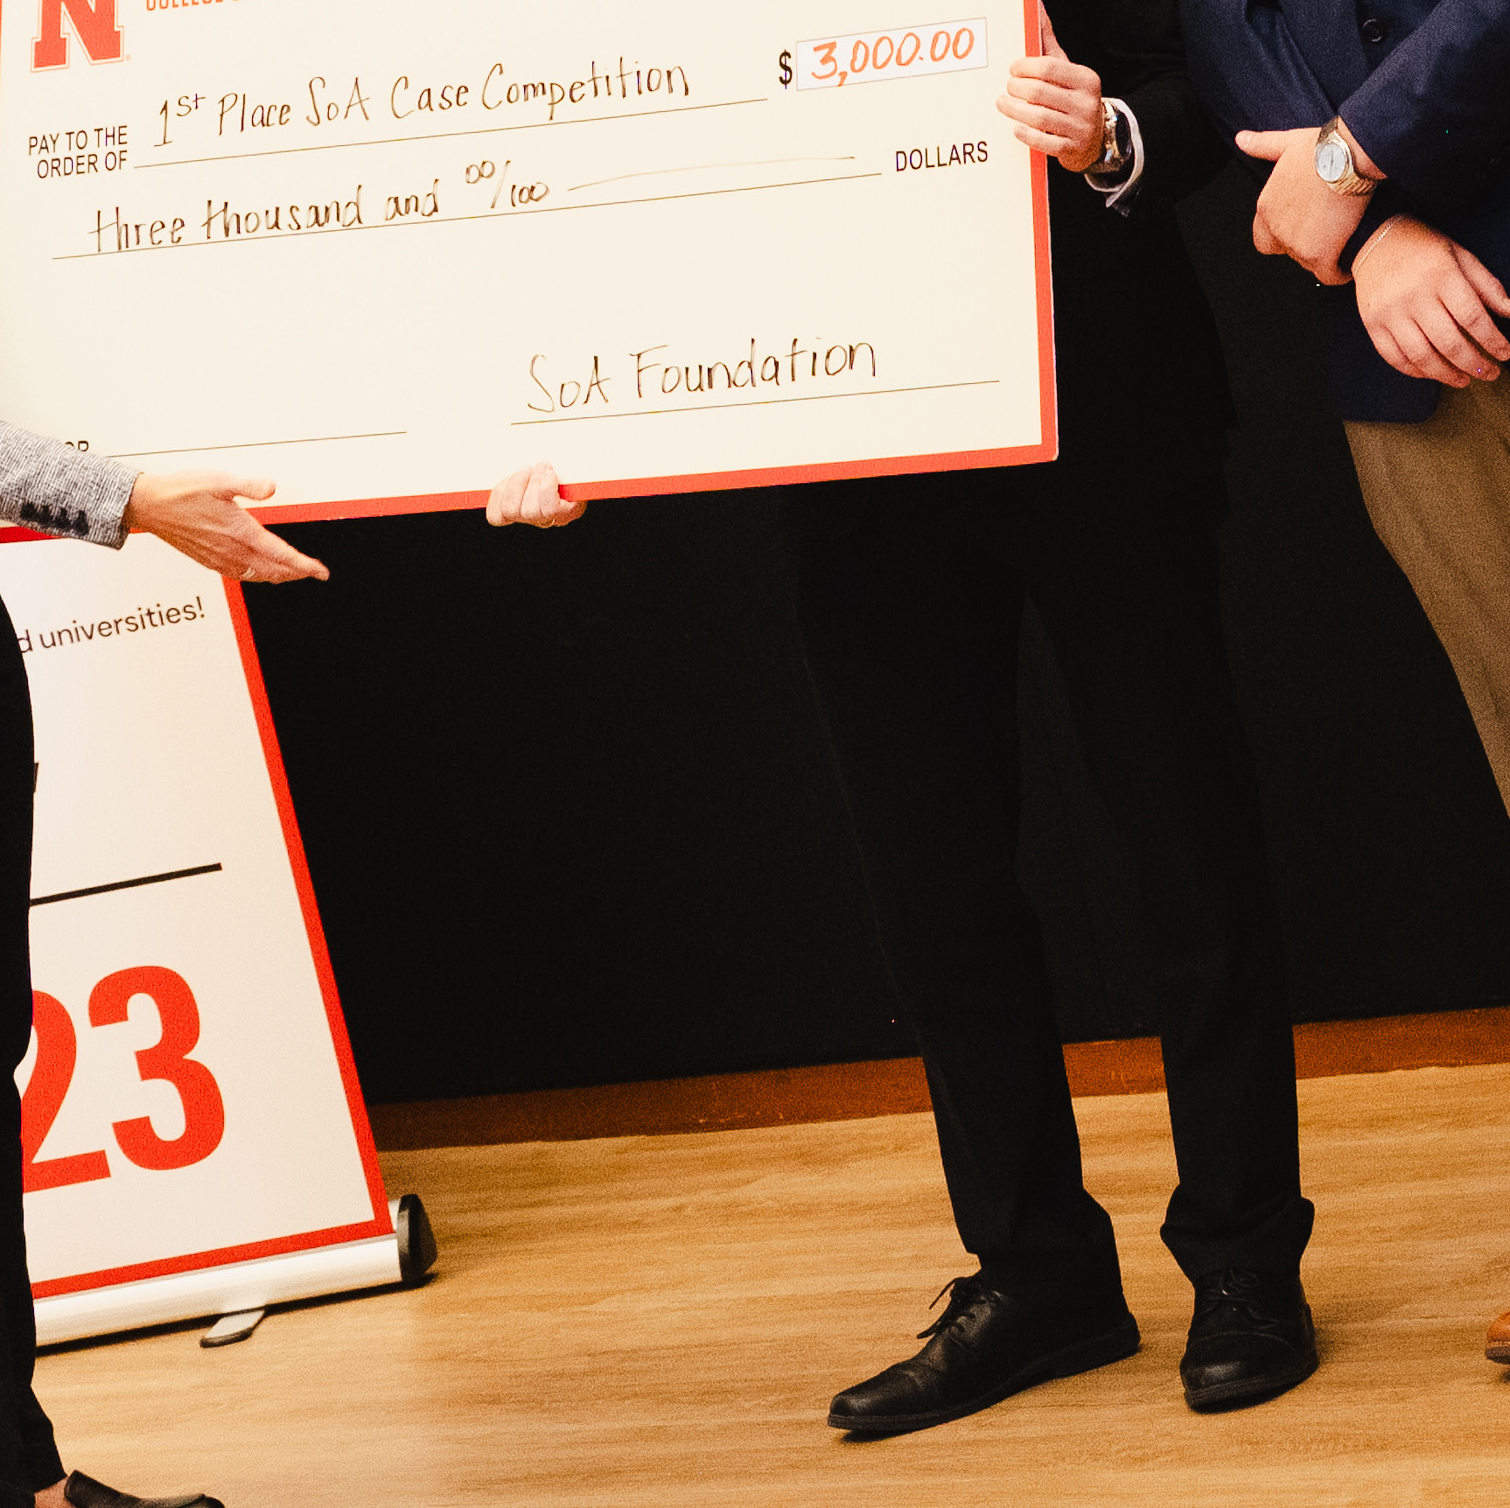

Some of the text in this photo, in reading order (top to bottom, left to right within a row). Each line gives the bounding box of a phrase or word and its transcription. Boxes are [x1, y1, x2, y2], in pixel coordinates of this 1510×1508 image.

[777, 26, 976, 88] $ 3,000.00
[217, 92, 292, 137] Place
[305, 76, 370, 127] SoA
[391, 75, 470, 119] Case
[481, 56, 690, 121] Competition
[28, 125, 128, 156] PAY TO THE
[37, 150, 128, 180] ORDER OF
[895, 140, 989, 173] DOLLARS
[200, 184, 364, 241] thousand
[385, 178, 440, 218] and
[527, 337, 878, 414] SoA Foundation
[39, 596, 206, 650] universities!
